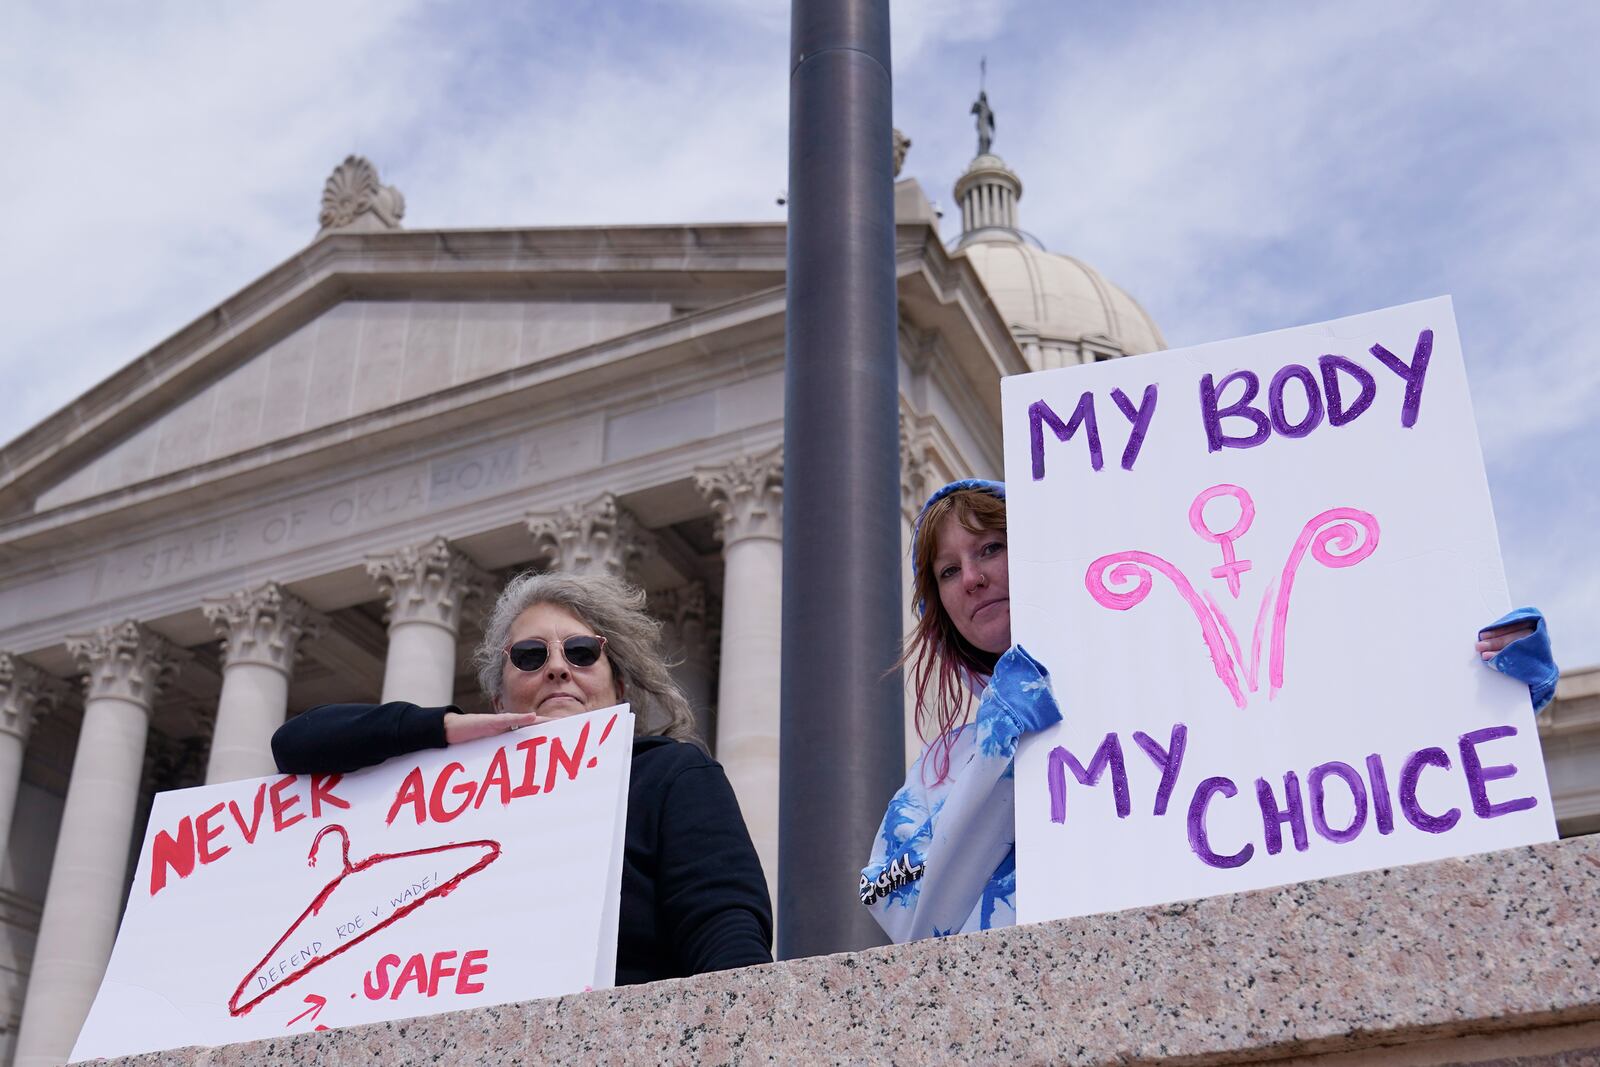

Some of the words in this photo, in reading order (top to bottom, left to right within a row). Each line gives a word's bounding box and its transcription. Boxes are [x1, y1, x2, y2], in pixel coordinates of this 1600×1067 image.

[1027, 382, 1158, 481] MY
[1199, 328, 1434, 454] BODY
[140, 528, 240, 582] STATE
[262, 509, 307, 545] OF
[328, 442, 546, 527] OKLAHOMA
[150, 773, 352, 897] NEVER
[386, 714, 619, 826] AGAIN!
[1047, 722, 1188, 825] MY
[1186, 725, 1539, 870] CHOICE
[257, 941, 323, 991] DEFEND
[335, 914, 365, 939] ROE
[390, 871, 438, 908] WADE!
[363, 949, 490, 1002] SAFE
